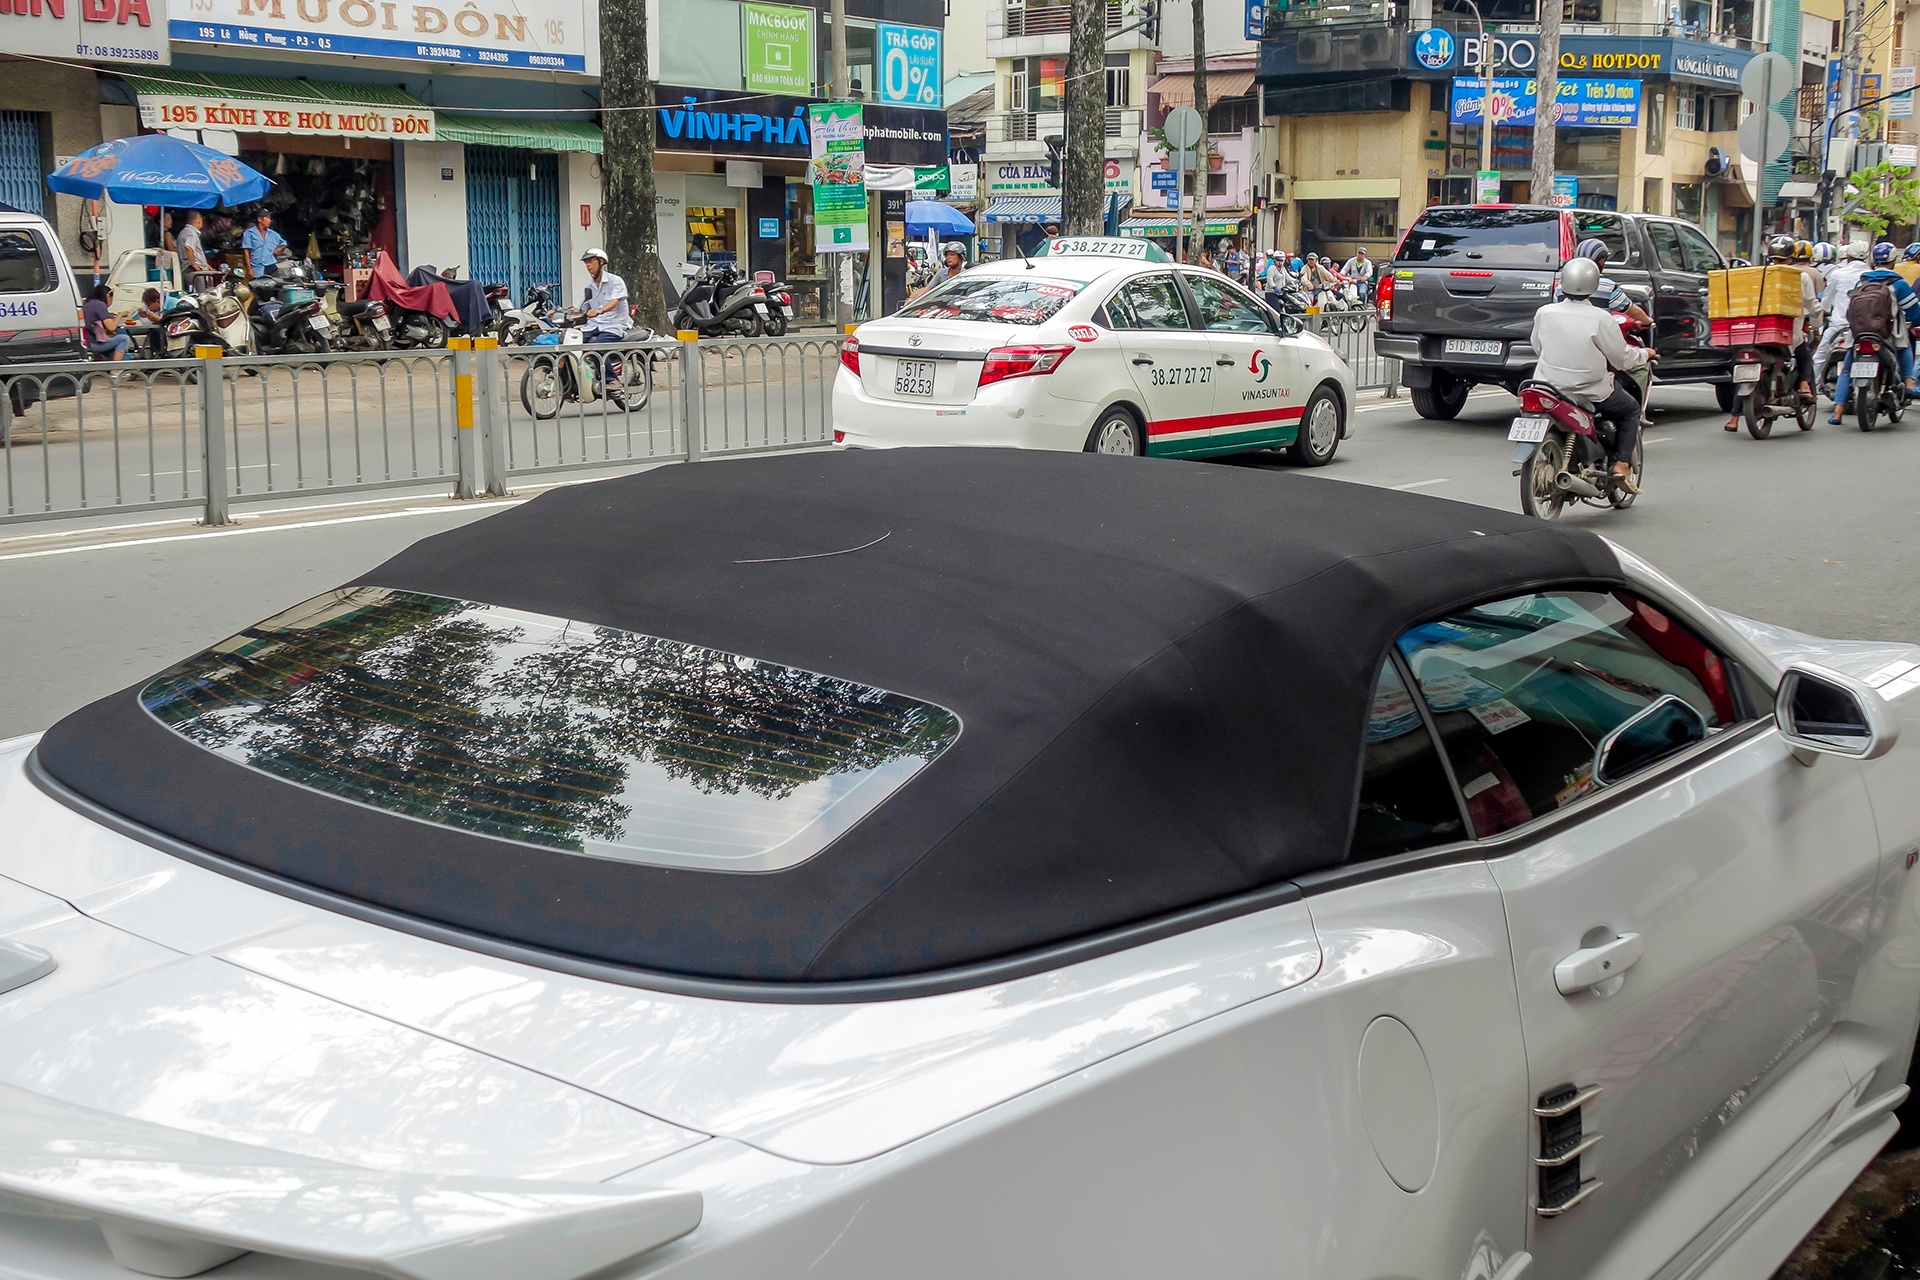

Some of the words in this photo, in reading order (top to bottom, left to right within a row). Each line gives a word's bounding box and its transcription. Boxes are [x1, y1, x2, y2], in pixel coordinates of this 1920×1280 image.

[412, 1, 528, 42] ĐÔN
[749, 11, 807, 31] MACBOOK
[198, 27, 215, 38] 195
[220, 28, 231, 39] Lê
[265, 32, 287, 46] Phong
[317, 37, 331, 49] Q.5
[544, 18, 566, 45] 195
[886, 29, 909, 48] TRẢ
[910, 33, 936, 51] GÓP
[1592, 53, 1661, 69] HOTPOT
[886, 48, 935, 103] 0%
[1586, 82, 1604, 98] Trên
[1604, 83, 1615, 99] 50
[161, 105, 198, 123] 195
[203, 102, 257, 126] KÍNH
[263, 109, 292, 128] XE
[297, 111, 332, 130] HƠI
[338, 112, 386, 133] MƯỜI
[392, 114, 430, 134] ĐÔN
[658, 96, 809, 145] VĨNHPHÁ
[998, 162, 1020, 179] CỬA
[1023, 163, 1053, 179] HÀN
[1071, 241, 1108, 253] 38.27
[1109, 243, 1127, 254] 27
[1128, 244, 1145, 255] 27
[1069, 327, 1099, 340] 9337.A
[905, 362, 926, 378] 51F
[1151, 368, 1182, 386] 38.27
[1185, 367, 1197, 384] 27
[1200, 366, 1212, 383] 27
[896, 377, 932, 394] 582.53
[1513, 430, 1540, 440] 2610
